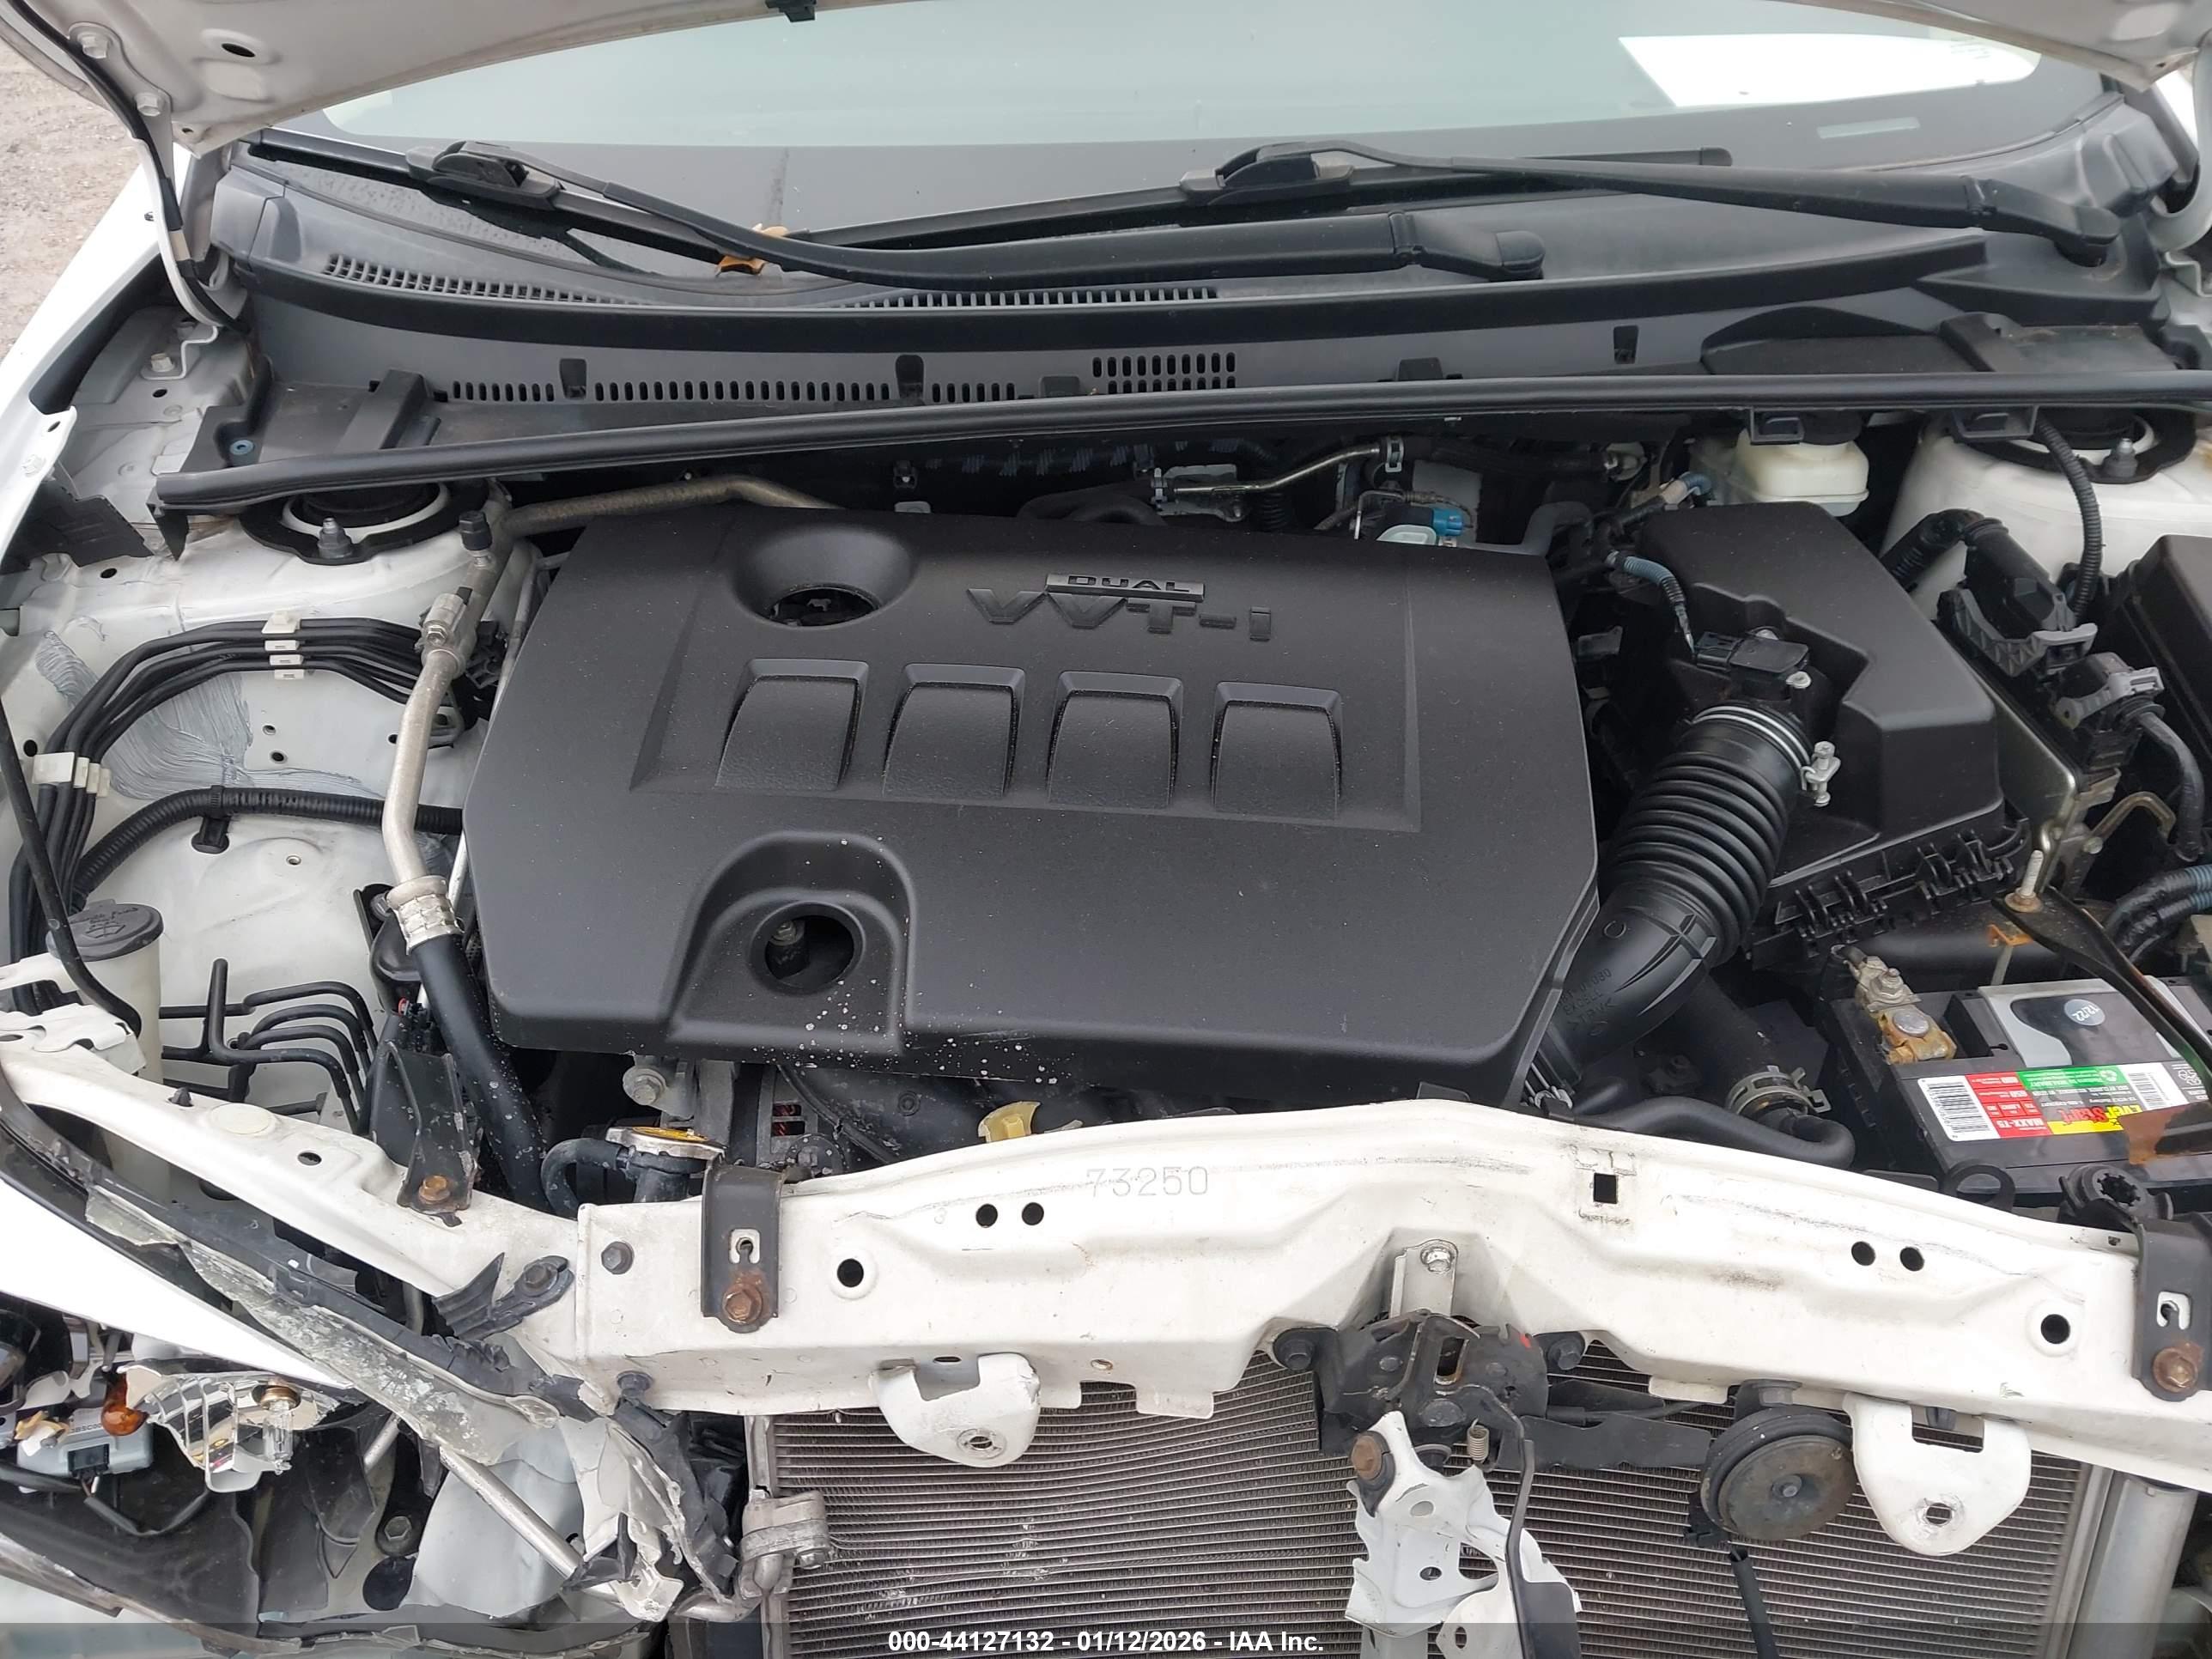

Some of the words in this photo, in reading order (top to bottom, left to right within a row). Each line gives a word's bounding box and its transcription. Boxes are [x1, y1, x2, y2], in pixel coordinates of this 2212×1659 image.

[1068, 574, 1189, 592] DUAL
[967, 587, 1271, 641] VVT-i
[2071, 1004, 2101, 1022] 12/22
[1086, 1166, 1208, 1198] 73250
